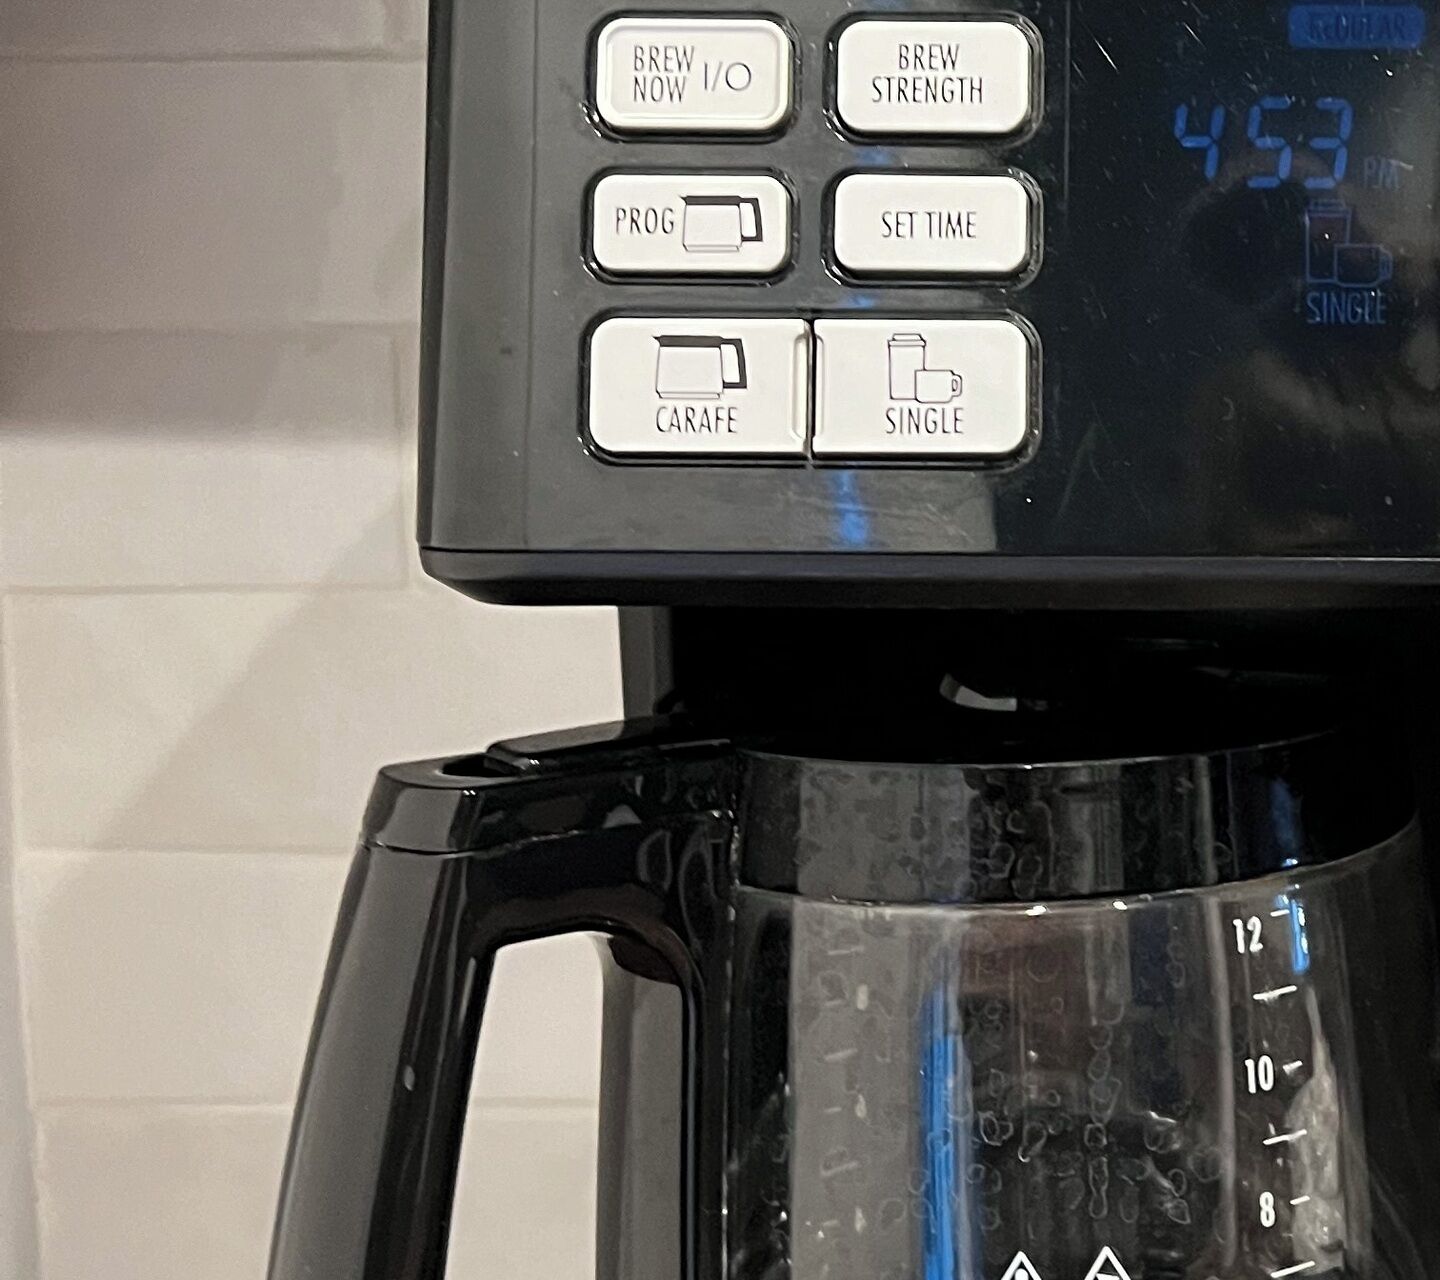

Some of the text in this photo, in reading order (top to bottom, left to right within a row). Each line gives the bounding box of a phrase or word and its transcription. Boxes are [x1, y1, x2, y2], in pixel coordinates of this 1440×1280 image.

[633, 44, 694, 73] BREW
[898, 42, 960, 71] BREW
[633, 75, 687, 103] NOW
[871, 76, 983, 104] STRENGTH
[615, 206, 675, 236] PROG
[881, 210, 976, 239] SET TIME
[1306, 292, 1387, 325] SINGLE
[655, 406, 739, 434] CARAFE
[885, 406, 964, 435] SINGLE
[1233, 916, 1263, 954] 12
[1244, 1055, 1275, 1094] 10
[1259, 1191, 1276, 1228] 8
